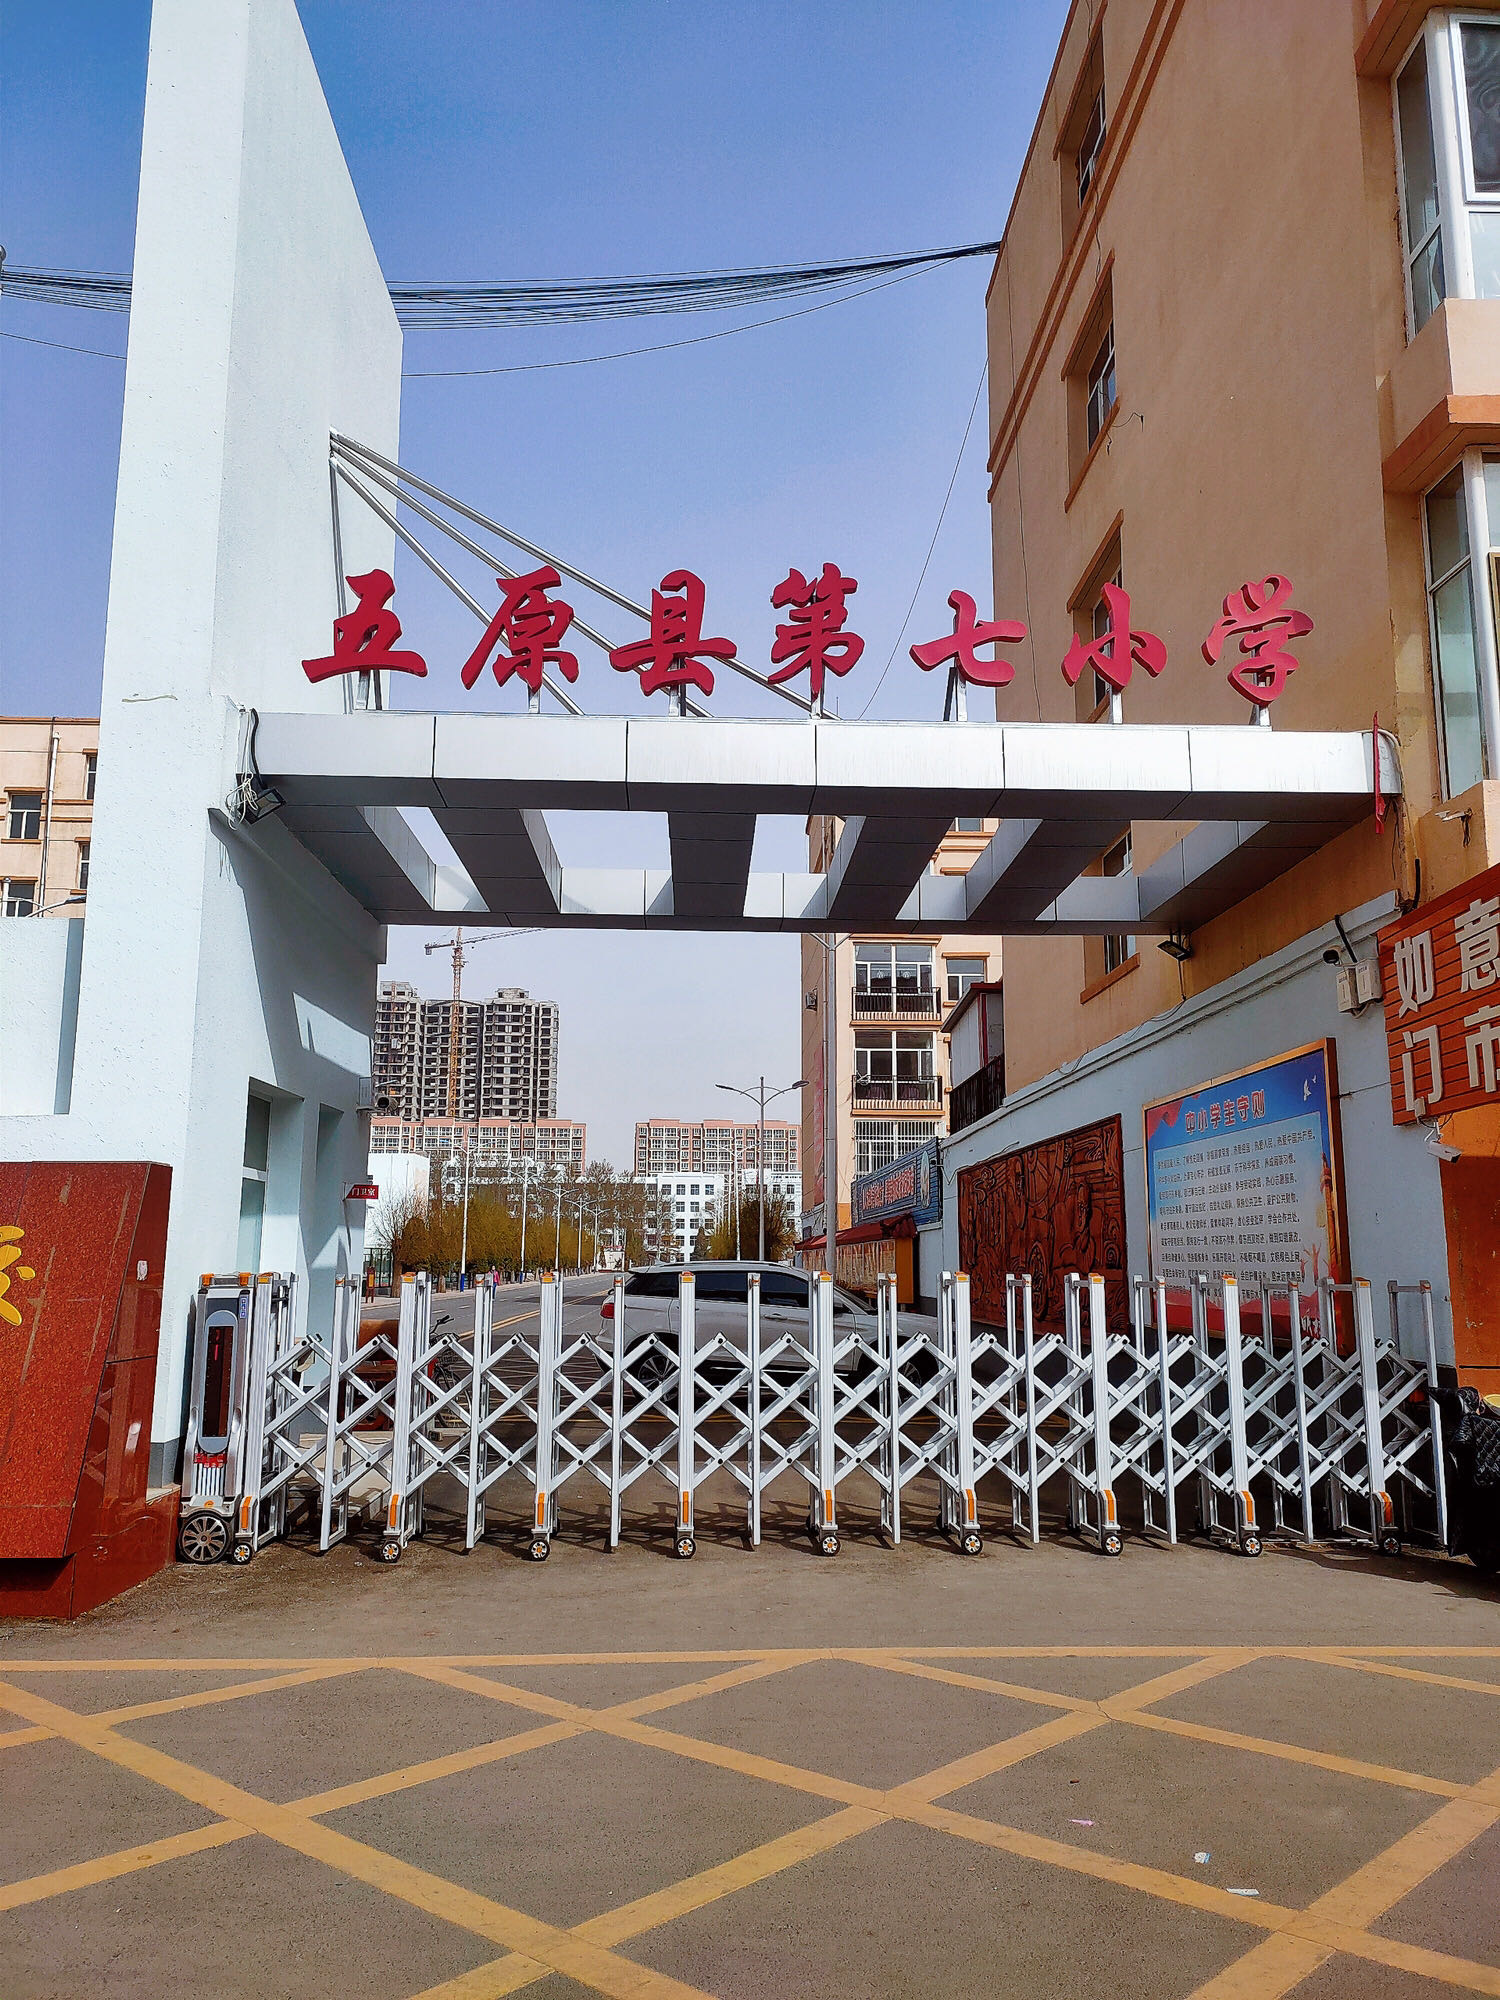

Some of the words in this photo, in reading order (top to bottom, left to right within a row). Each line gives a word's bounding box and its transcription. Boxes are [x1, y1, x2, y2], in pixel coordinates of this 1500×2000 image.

[302, 563, 1313, 706] 五原县第七小学
[1393, 896, 1500, 1019] 如意
[1185, 1089, 1266, 1136] 中小学生守则
